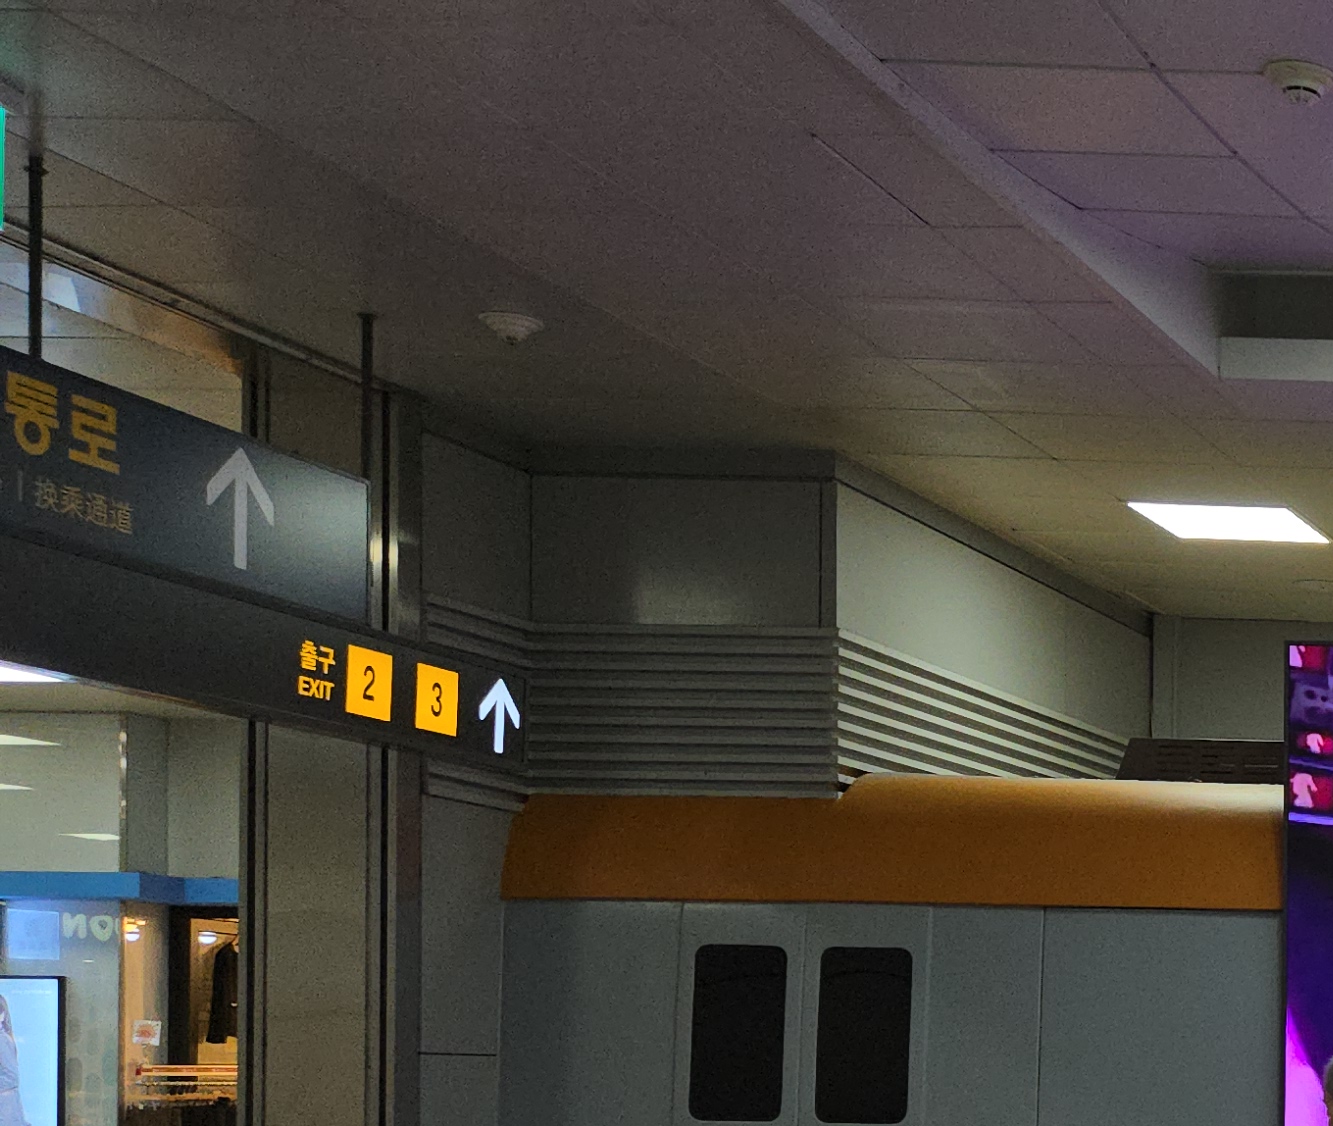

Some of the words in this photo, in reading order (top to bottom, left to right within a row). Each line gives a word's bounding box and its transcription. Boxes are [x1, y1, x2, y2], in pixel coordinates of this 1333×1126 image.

[300, 640, 336, 675] 출구
[297, 676, 335, 701] EXIT
[362, 665, 376, 702] 2
[430, 681, 443, 718] 3
